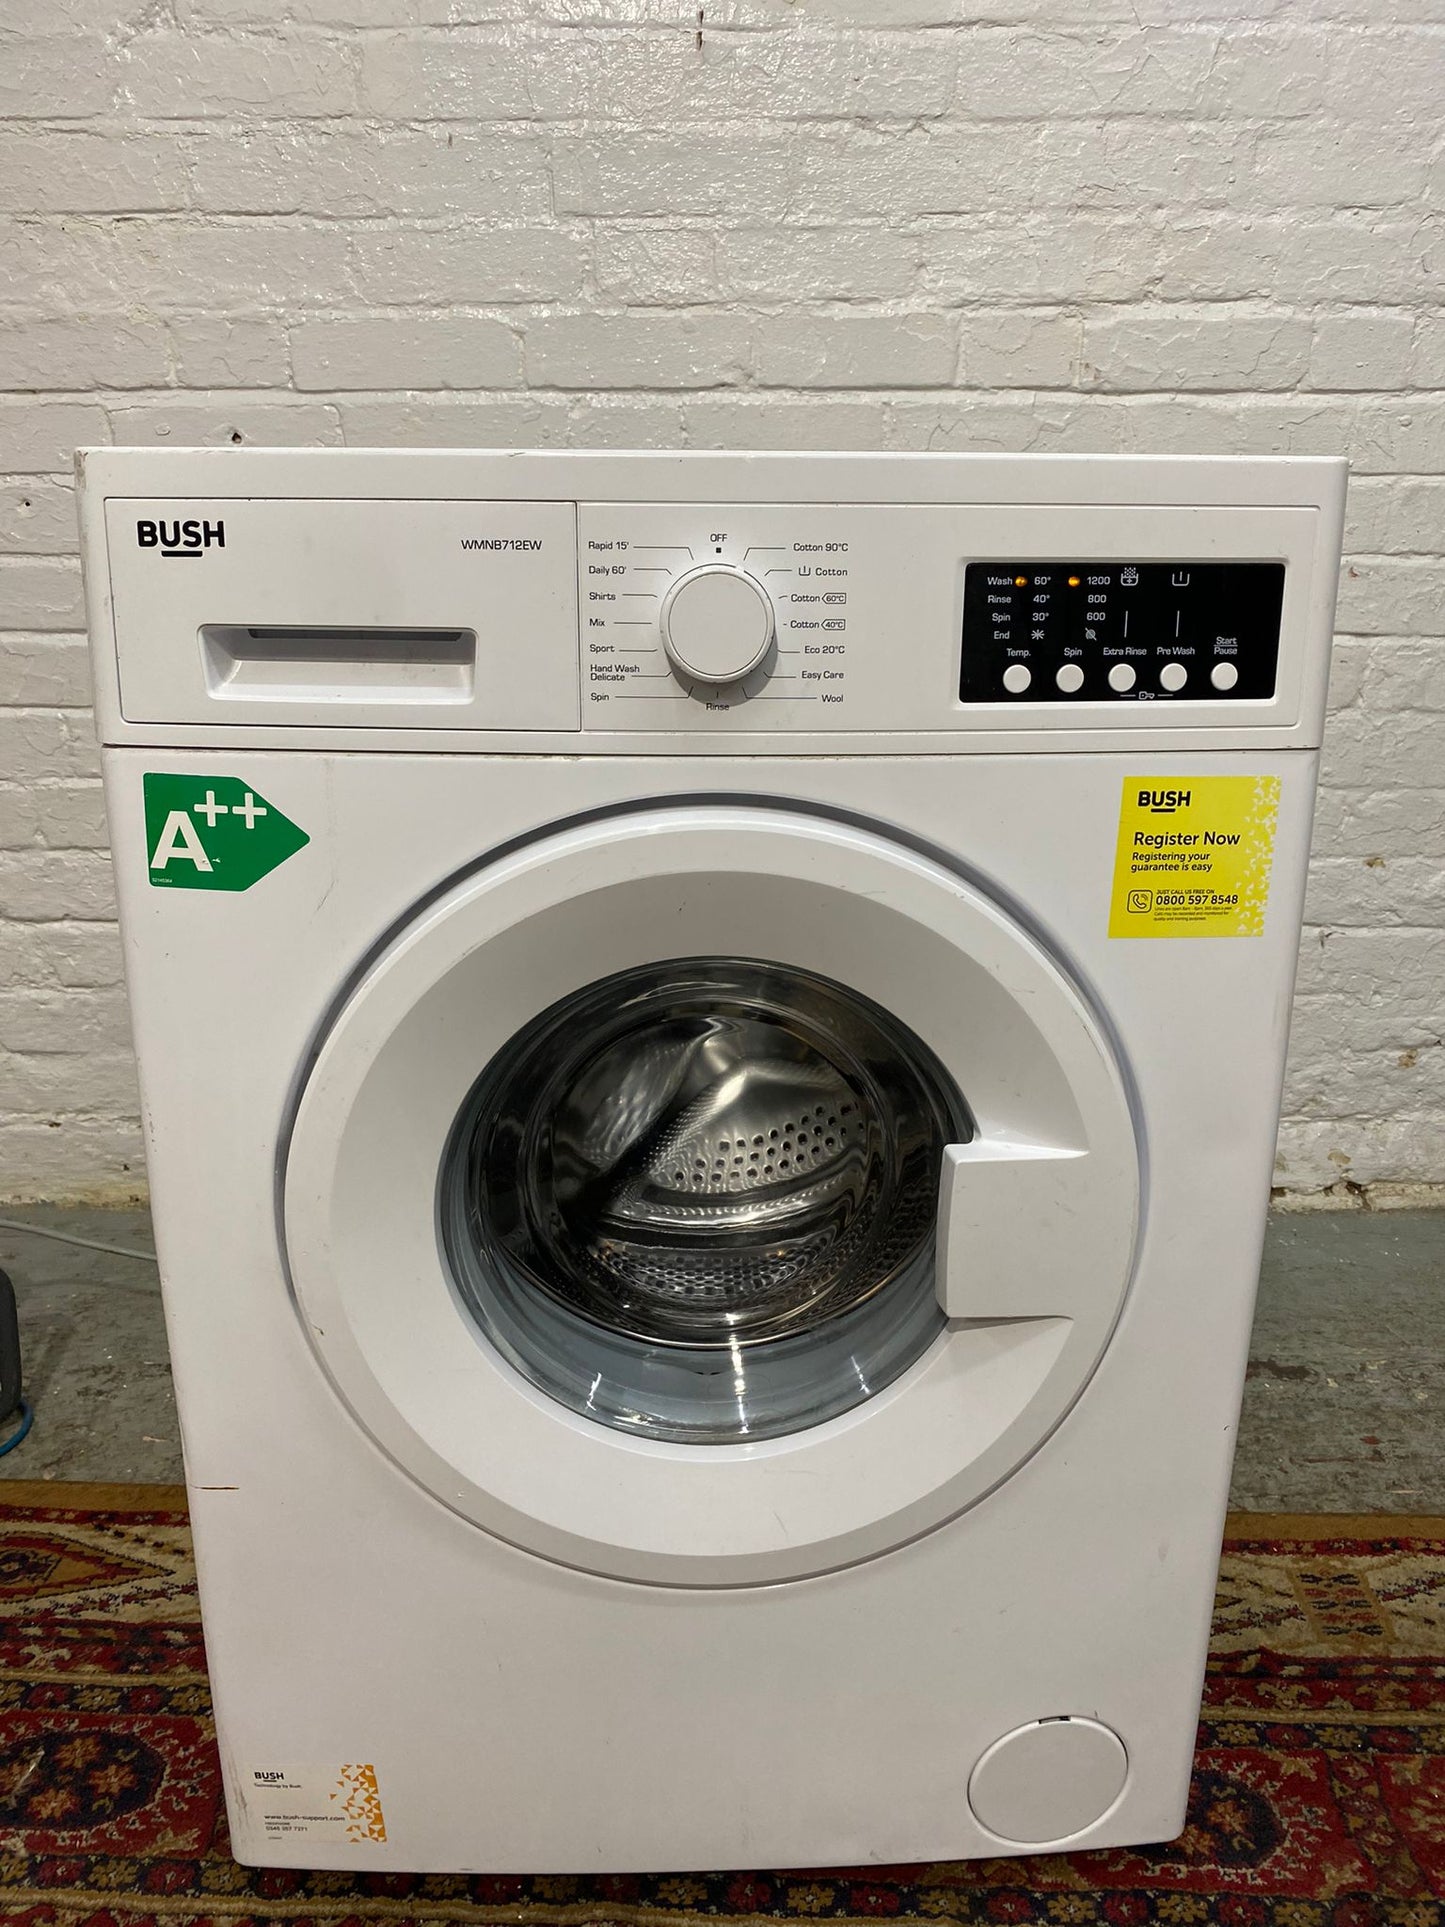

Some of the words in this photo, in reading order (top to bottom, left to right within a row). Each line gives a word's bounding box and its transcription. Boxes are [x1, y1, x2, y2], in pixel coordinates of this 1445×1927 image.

[137, 520, 226, 548] BUSH
[710, 534, 727, 543] OFF
[461, 539, 542, 551] WMNB712EW
[588, 541, 613, 551] Rapid
[793, 543, 823, 551] Cotton
[825, 543, 849, 551] 90°C
[588, 566, 610, 576] Daily
[815, 567, 848, 576] Cotton
[987, 576, 1013, 585] Wash
[1034, 576, 1052, 585] 60°
[1087, 576, 1111, 585] 1200
[589, 592, 616, 601] Shirts
[791, 594, 820, 602] Cotton
[987, 594, 1012, 603] Rinse
[1033, 594, 1050, 603] 40°
[1087, 594, 1107, 603] 800
[992, 612, 1011, 623] Spin
[1032, 612, 1050, 621] 30°
[1086, 612, 1106, 620] 600
[589, 618, 606, 626] Mix
[790, 620, 820, 628] Cotton
[993, 630, 1010, 639] End
[1216, 636, 1237, 645] Start
[589, 644, 615, 654] Sport
[804, 645, 820, 654] Eco
[822, 645, 845, 654] 20°C
[1006, 648, 1031, 658] Temp.
[1063, 647, 1083, 658] Spin
[1103, 647, 1124, 655] Extra
[1125, 647, 1147, 655] Rinse
[1156, 647, 1171, 655] Pre
[1172, 647, 1195, 655] Wash
[1213, 646, 1238, 655] Pause
[590, 664, 612, 672] Hand
[614, 664, 640, 672] Wash
[590, 673, 625, 681] Delicate
[801, 670, 821, 680] Easy
[823, 670, 844, 679] Care
[591, 692, 610, 702] Spin
[822, 694, 844, 702] Wool
[706, 702, 730, 711] Rinse
[1137, 790, 1191, 807] BUSH
[150, 790, 268, 872] A++
[1133, 831, 1199, 849] Register
[1203, 831, 1241, 845] Now
[1132, 851, 1186, 862] Registering
[1187, 853, 1211, 862] your
[1130, 863, 1179, 873] guarantee
[1181, 862, 1189, 871] is
[1191, 864, 1213, 872] easy
[1156, 895, 1185, 905] 0800
[1188, 895, 1209, 905] 597
[1210, 895, 1239, 904] 8548
[254, 1772, 284, 1780] BUSH
